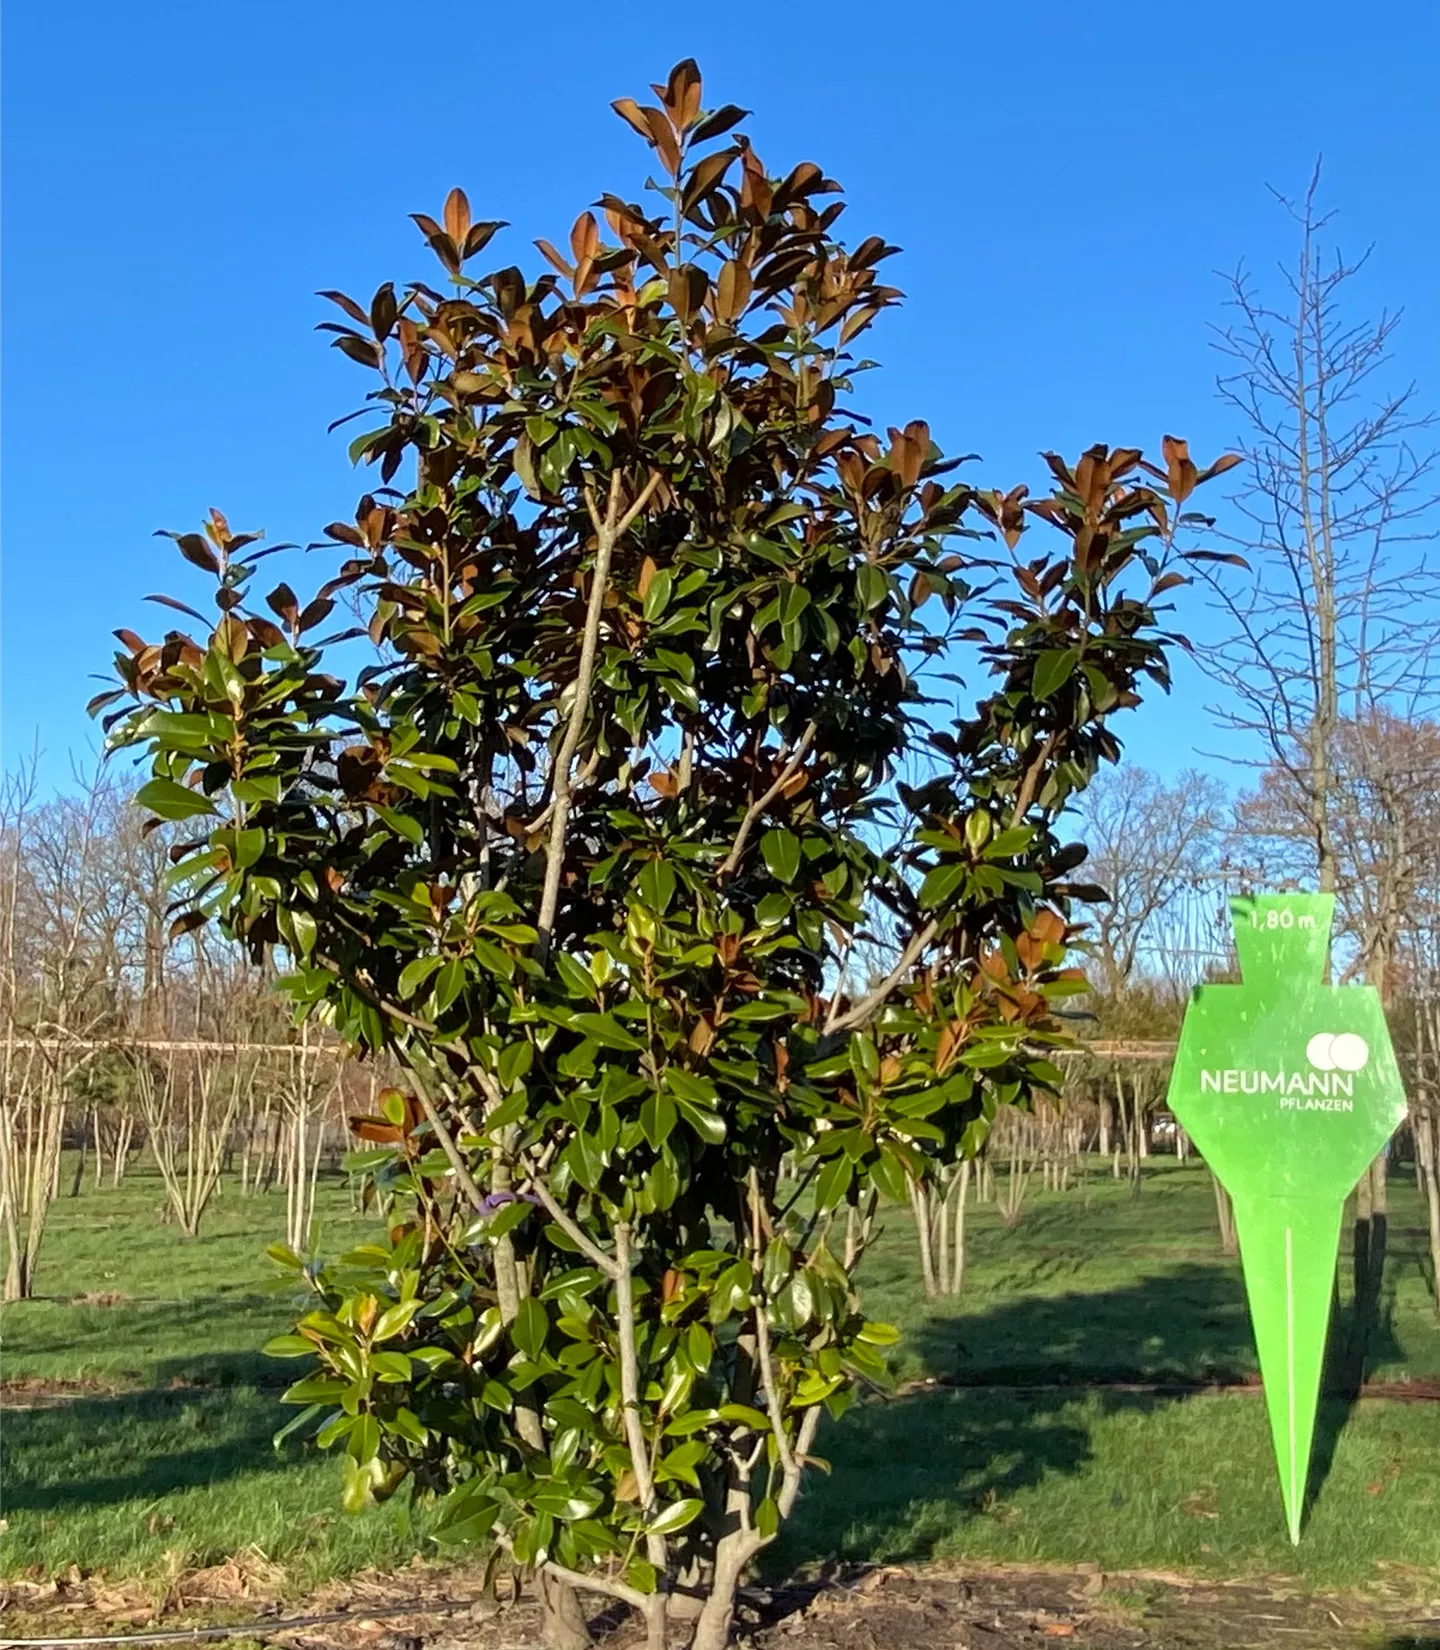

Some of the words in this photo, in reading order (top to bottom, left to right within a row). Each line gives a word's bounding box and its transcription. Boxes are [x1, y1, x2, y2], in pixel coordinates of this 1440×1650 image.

[1250, 910, 1293, 930] 1,80
[1298, 914, 1316, 929] m
[1200, 1069, 1354, 1096] NEUMANN
[1279, 1098, 1353, 1113] PFLANZEN
